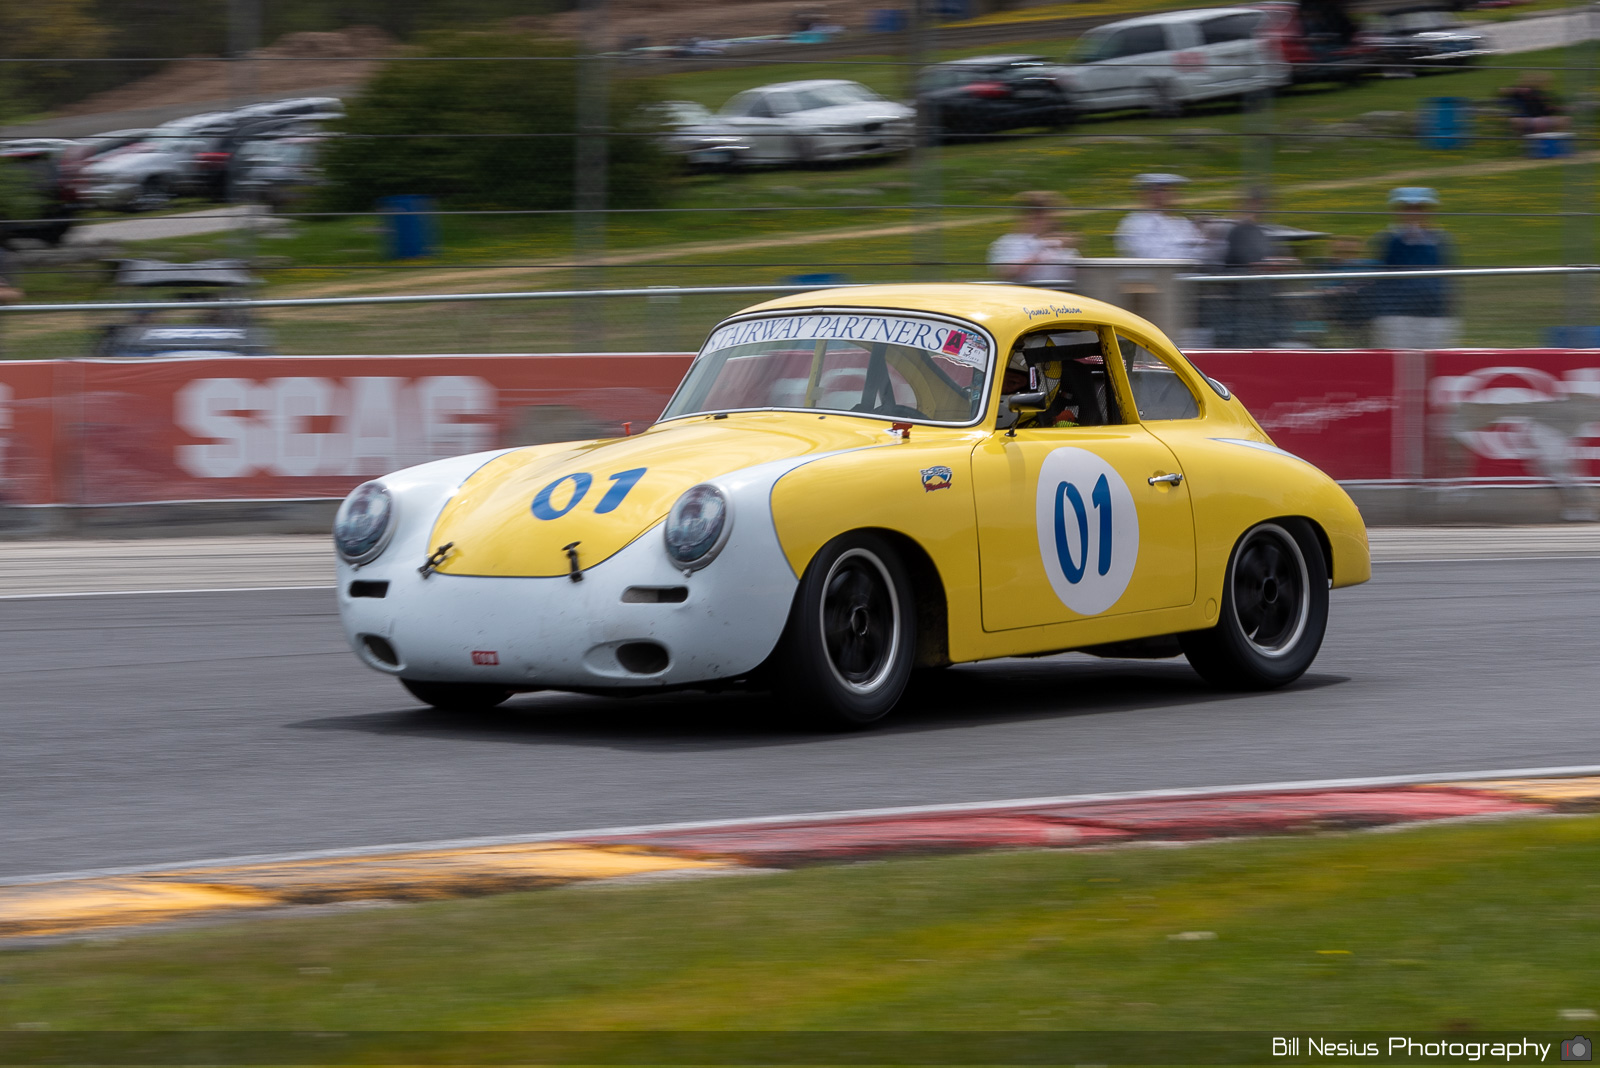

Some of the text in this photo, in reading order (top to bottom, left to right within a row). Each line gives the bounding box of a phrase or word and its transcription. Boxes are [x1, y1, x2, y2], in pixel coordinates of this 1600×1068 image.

[706, 316, 813, 353] STAIRWAY
[809, 315, 950, 350] PARTNERS
[947, 333, 962, 348] A
[174, 375, 497, 477] SCAG
[531, 467, 648, 521] 01
[1053, 472, 1113, 585] 01
